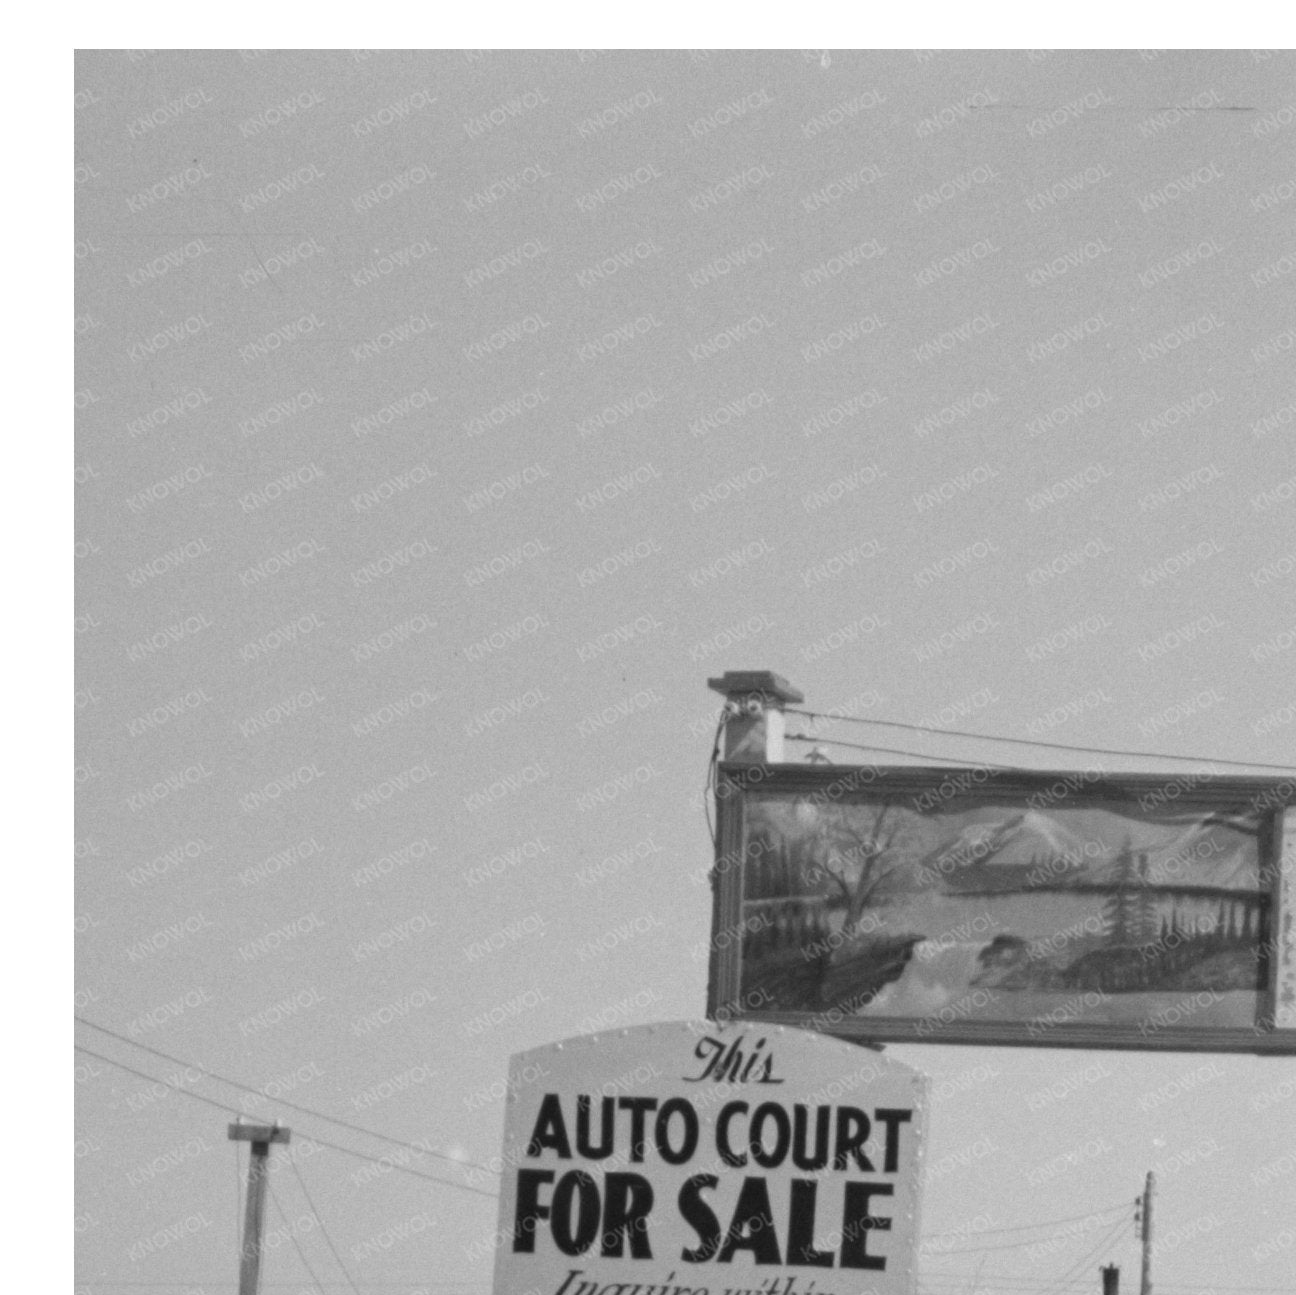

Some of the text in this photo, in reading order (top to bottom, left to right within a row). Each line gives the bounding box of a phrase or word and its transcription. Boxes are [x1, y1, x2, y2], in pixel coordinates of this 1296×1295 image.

[682, 1035, 785, 1084] This
[526, 1093, 912, 1173] AUTO COURT
[512, 1168, 895, 1271] FOR SALE
